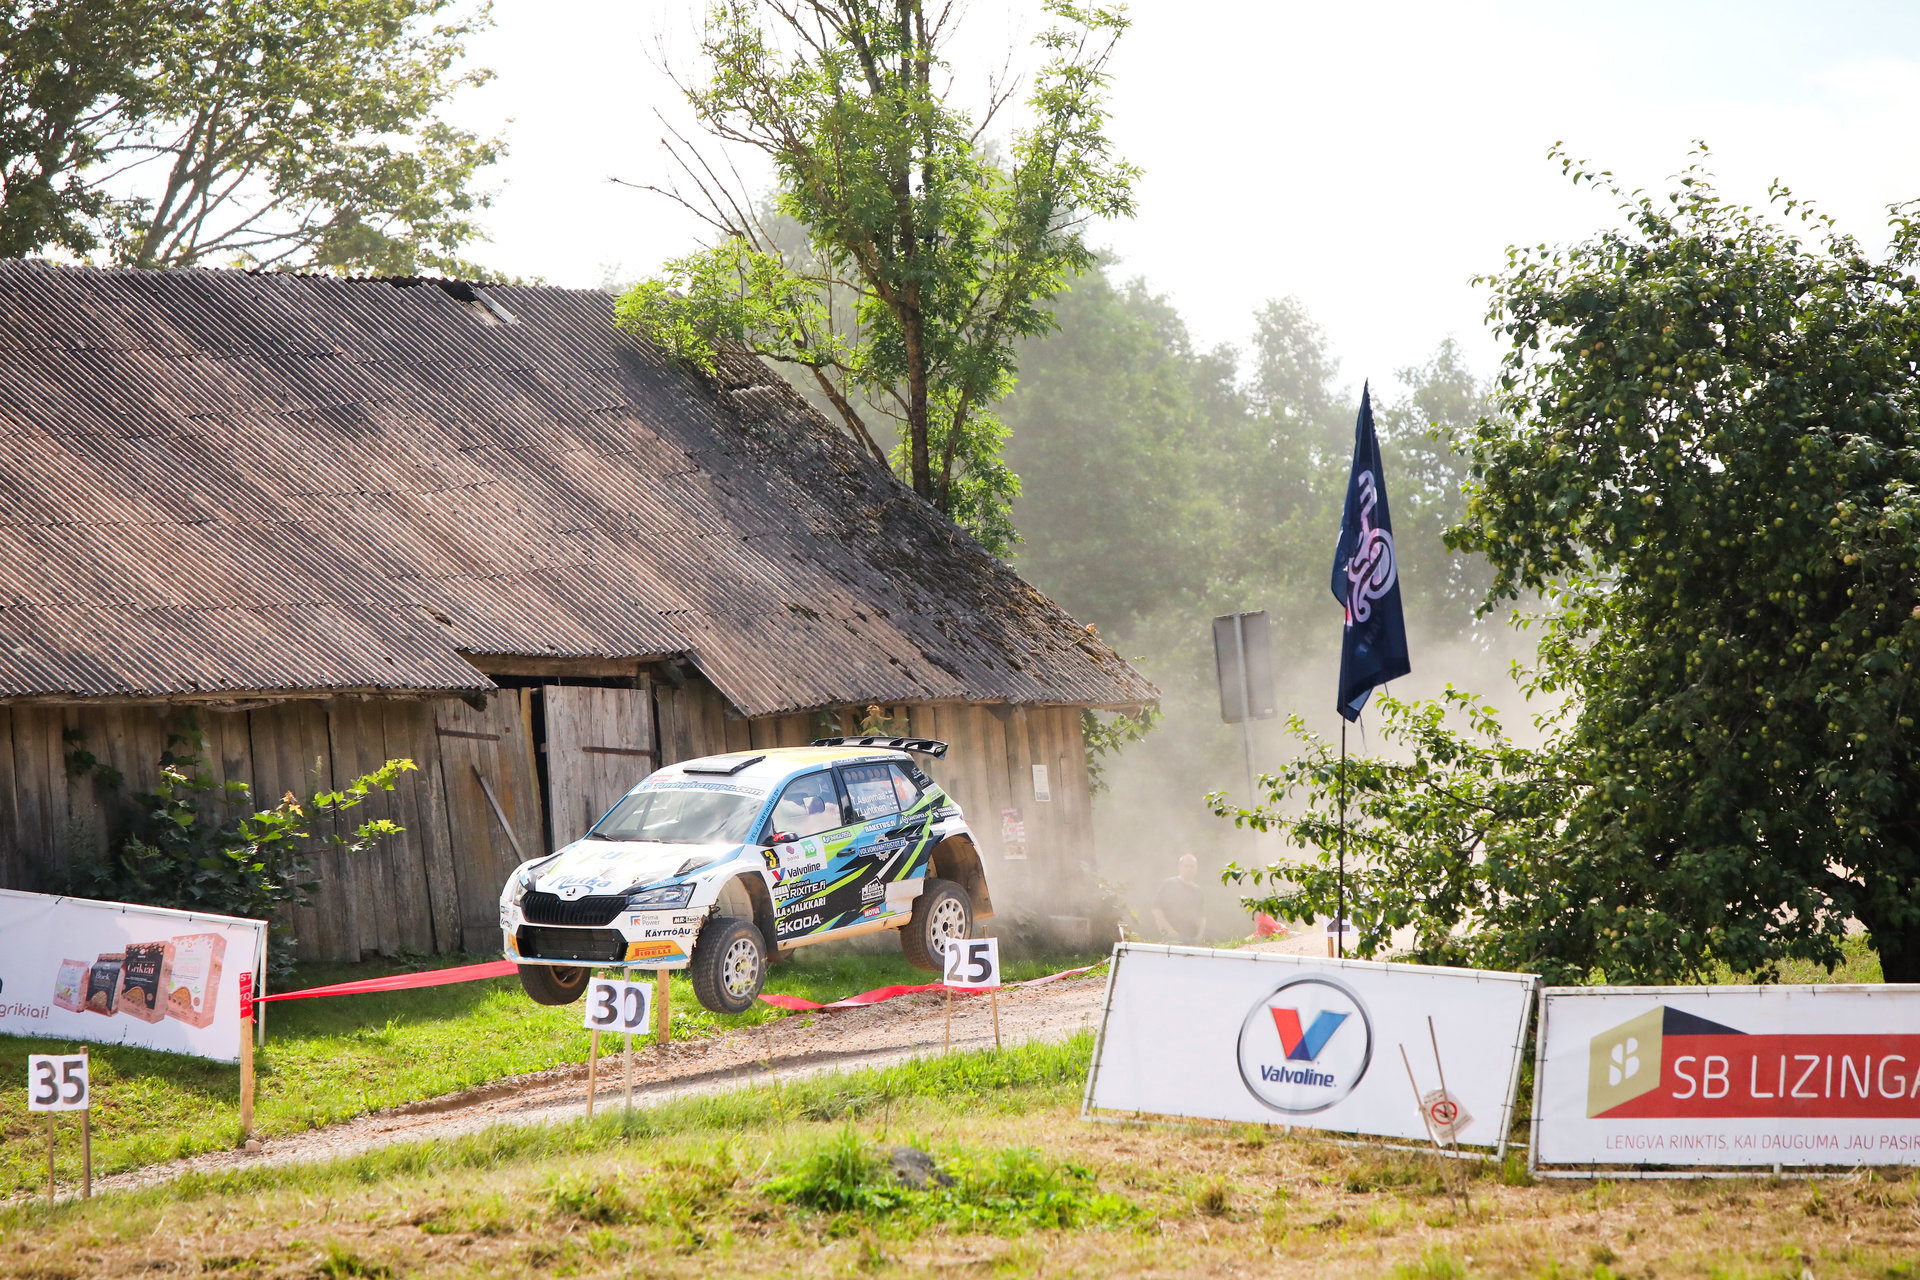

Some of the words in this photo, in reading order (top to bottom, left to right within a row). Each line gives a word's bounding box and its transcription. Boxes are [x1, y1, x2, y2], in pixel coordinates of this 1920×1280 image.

[805, 843, 816, 854] 15
[764, 850, 777, 869] 3
[787, 862, 821, 878] Valvoline
[864, 907, 881, 918] MOTUL
[777, 914, 822, 936] ŠKODA
[635, 944, 672, 957] PIRELLI
[947, 943, 993, 984] 25
[0, 1002, 50, 1020] grikiai!
[591, 984, 645, 1029] 30
[35, 1060, 85, 1105] 35
[1260, 1064, 1336, 1088] Valvoline
[1672, 1055, 1730, 1099] SB
[1606, 1134, 1665, 1149] LENGVA
[1669, 1134, 1730, 1151] RINKTIS,
[1734, 1134, 1757, 1150] KAI
[1761, 1134, 1839, 1149] DAUGUMA
[1844, 1134, 1874, 1149] JAU
